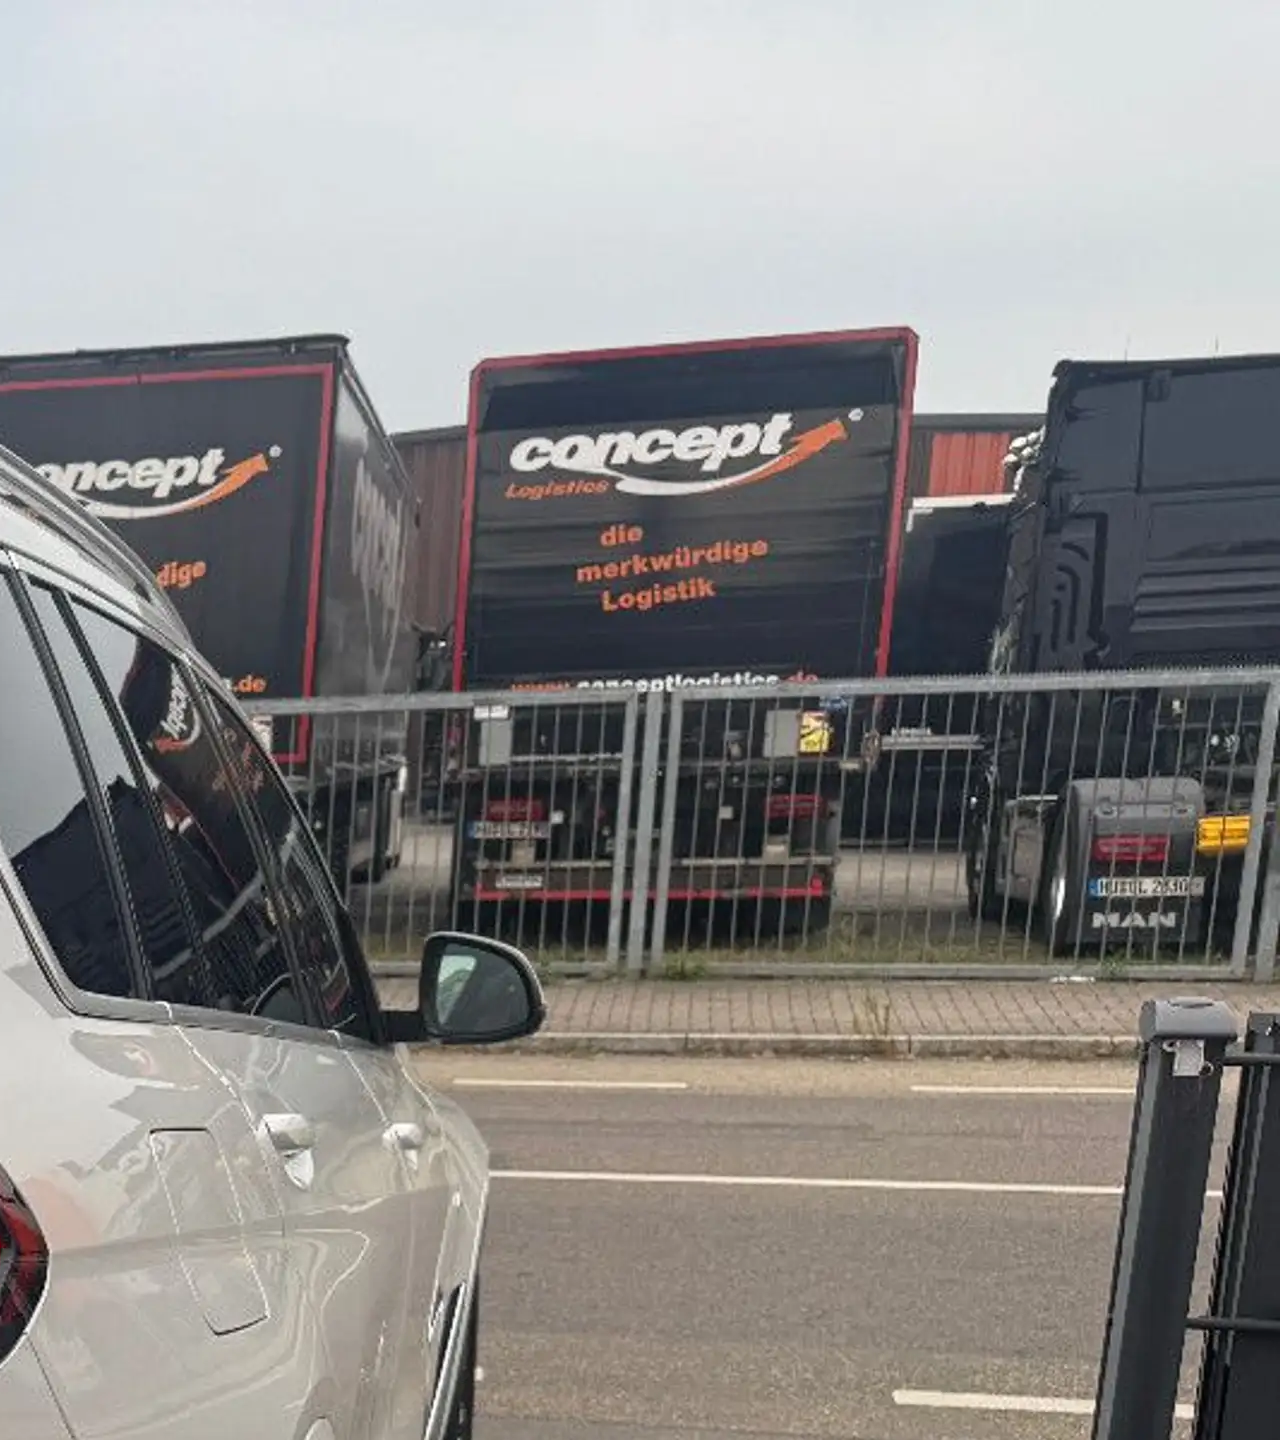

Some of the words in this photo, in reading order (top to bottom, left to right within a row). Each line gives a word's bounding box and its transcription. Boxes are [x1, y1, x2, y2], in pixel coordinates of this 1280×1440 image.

[510, 413, 792, 472] concept
[37, 448, 224, 498] oncept
[505, 480, 609, 500] Logistics
[600, 524, 643, 546] die
[576, 539, 768, 583] merkwürdige
[601, 577, 716, 612] Logistik
[1092, 911, 1177, 928] MAN
